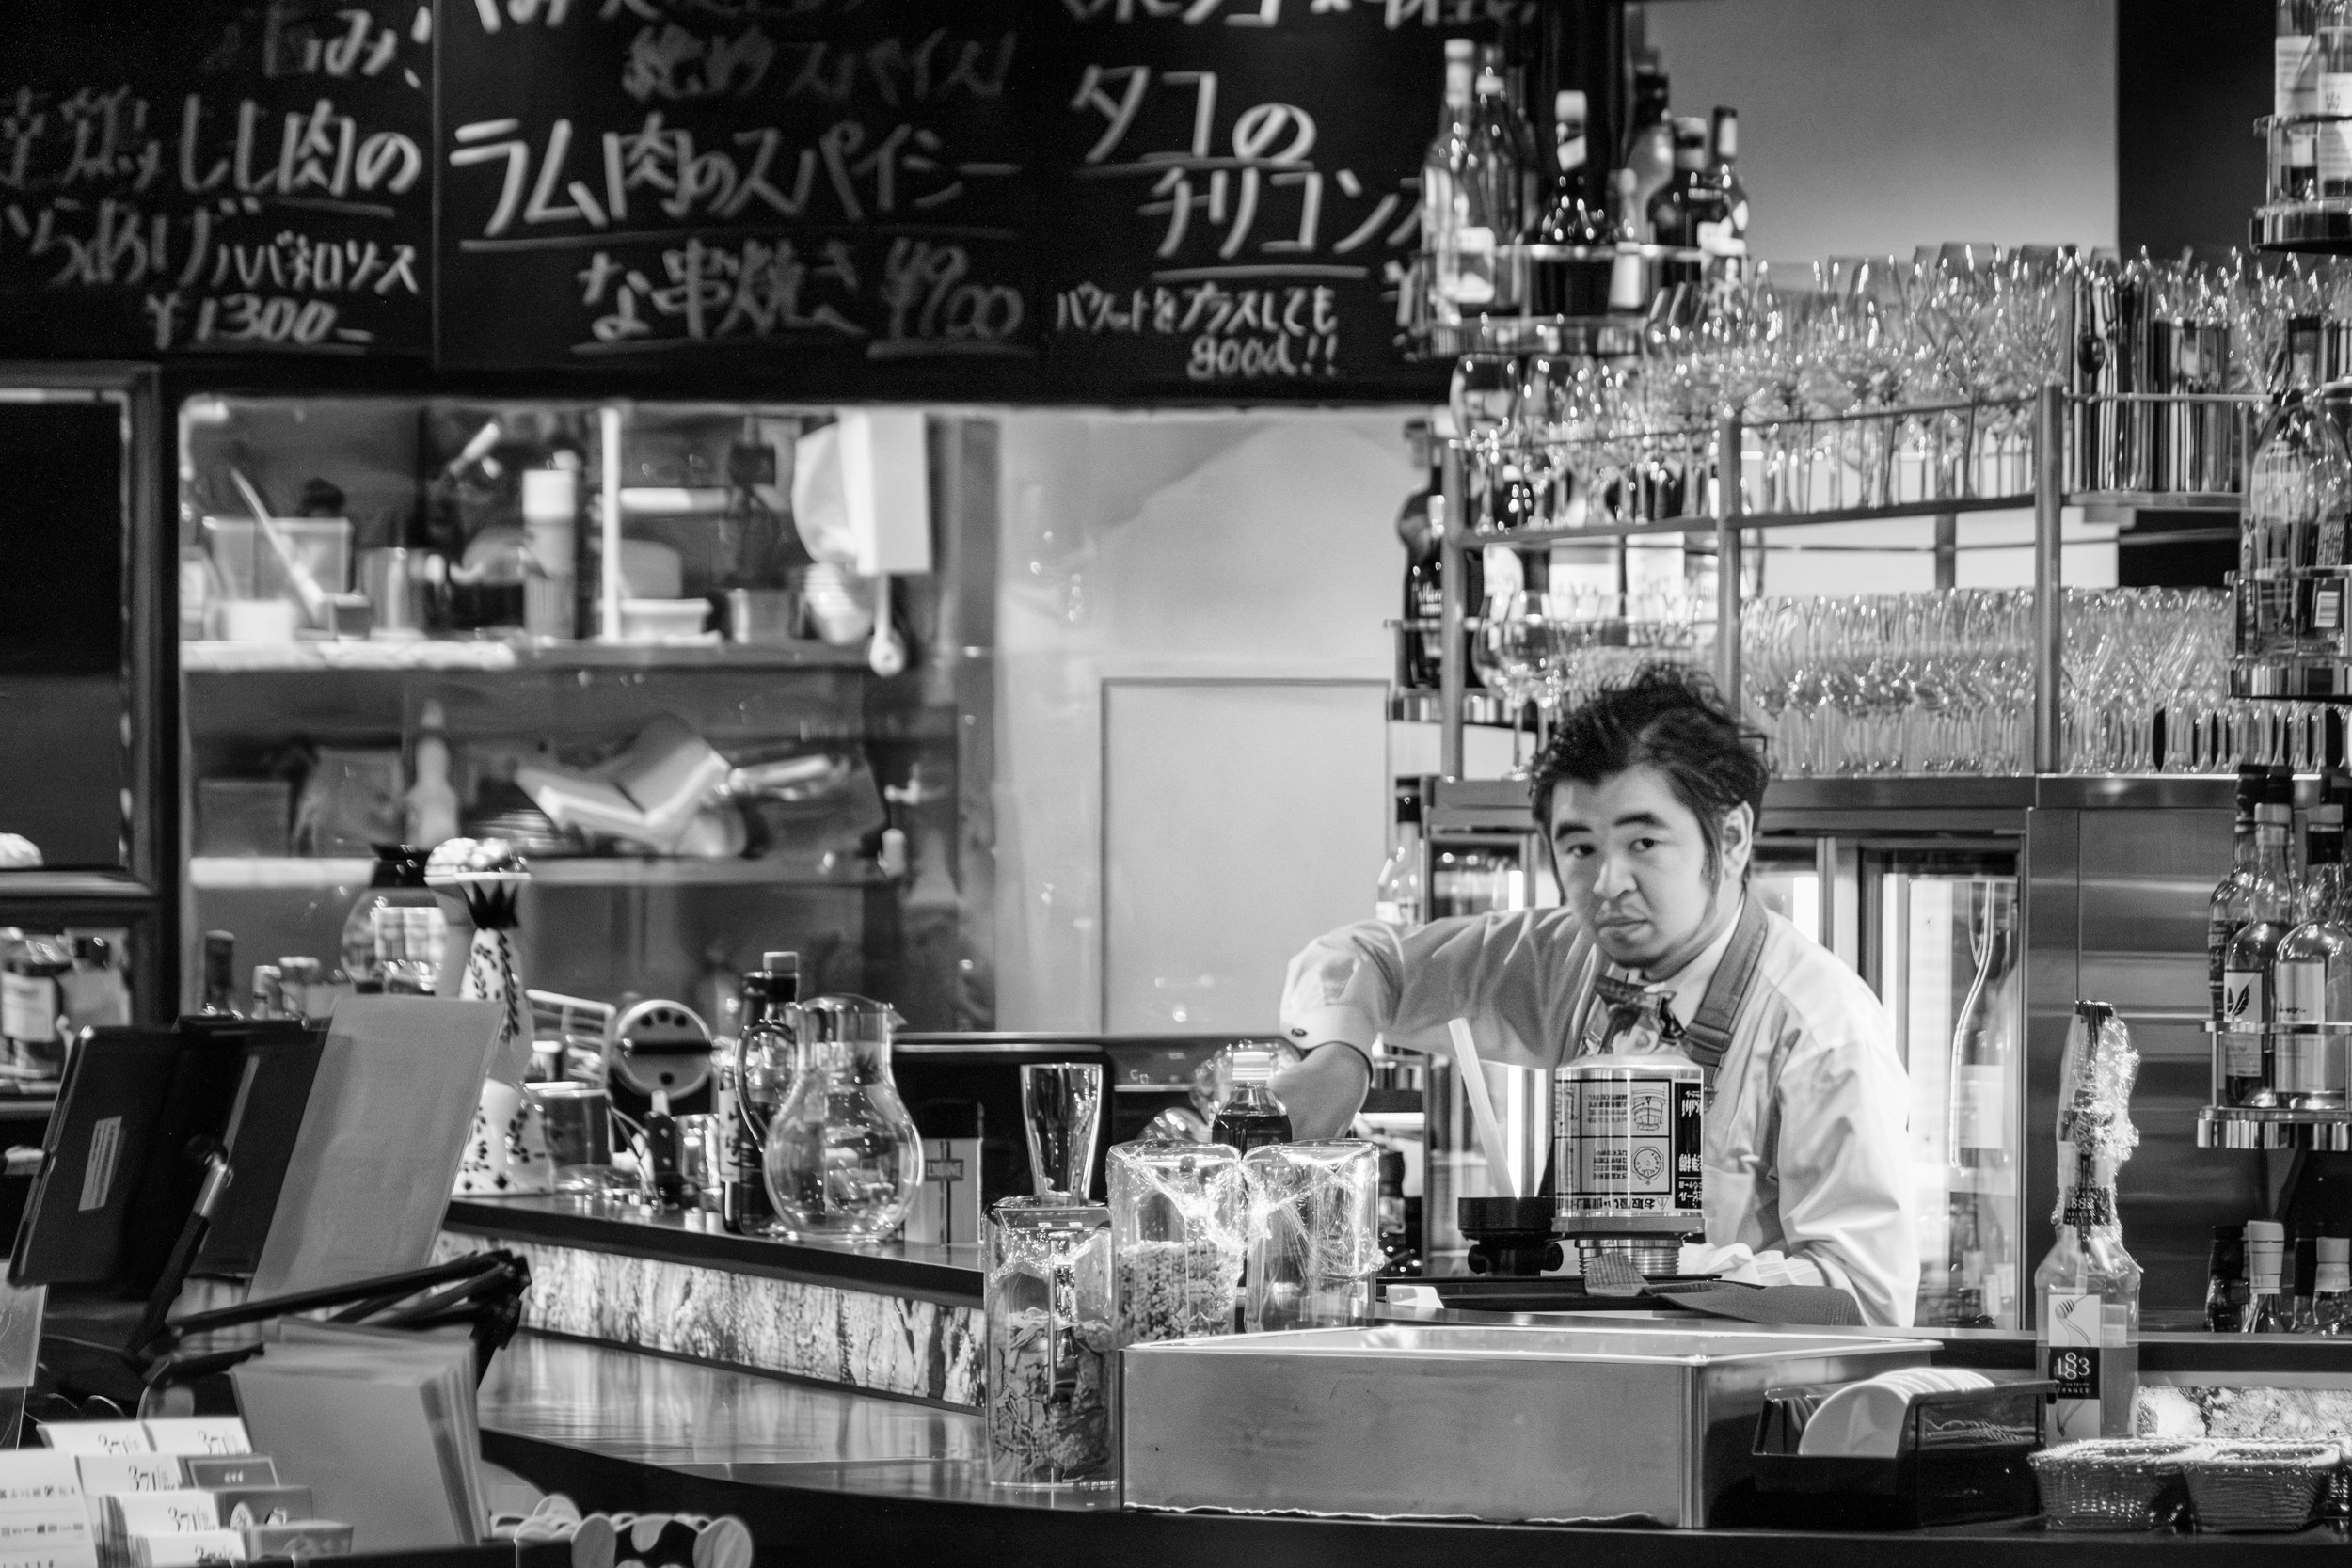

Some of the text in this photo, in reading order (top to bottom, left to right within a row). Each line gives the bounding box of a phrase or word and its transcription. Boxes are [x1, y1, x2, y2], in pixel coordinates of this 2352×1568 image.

[1071, 64, 1317, 164] タコの
[449, 112, 1023, 237] ラム肉のスパイシー
